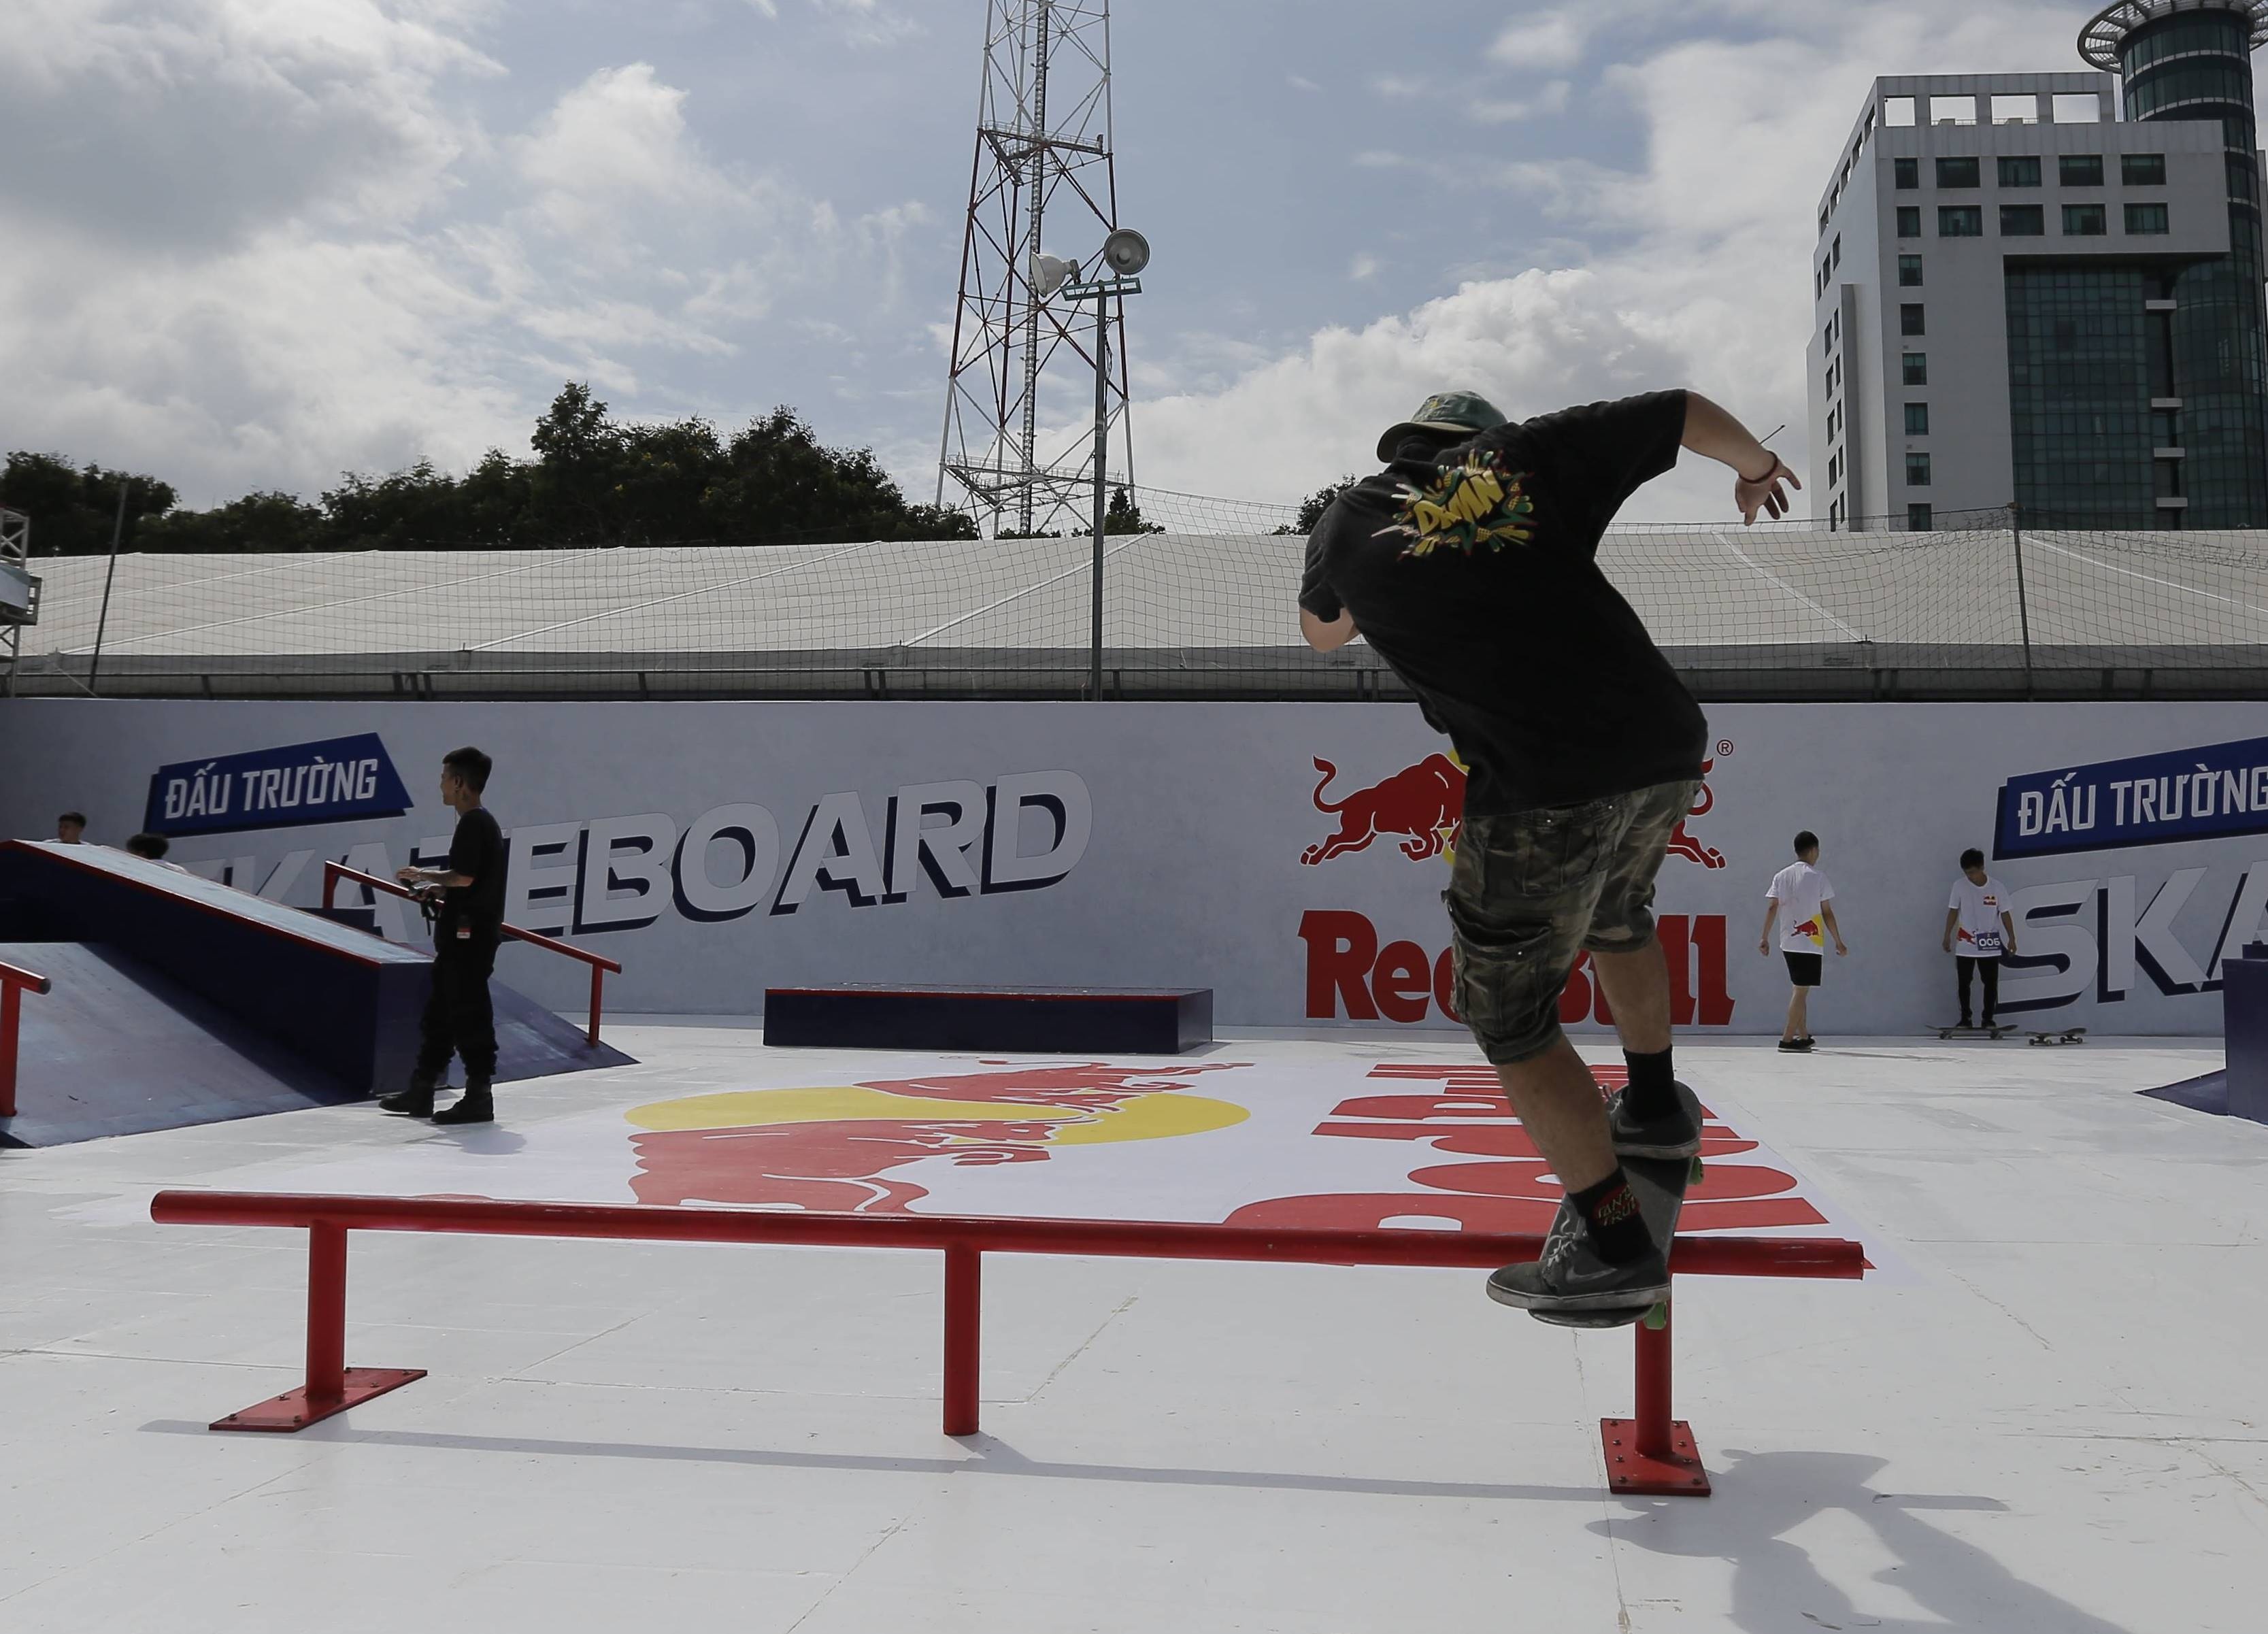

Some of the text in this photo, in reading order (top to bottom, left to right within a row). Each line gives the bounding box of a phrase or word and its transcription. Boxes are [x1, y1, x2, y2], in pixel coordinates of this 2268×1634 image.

[165, 756, 378, 819] ĐẤU TRƯỜNG
[2017, 763, 2268, 837] ĐẤU TRƯỜNG
[182, 769, 1093, 944] AEBOARD
[1298, 910, 1465, 1024] Re
